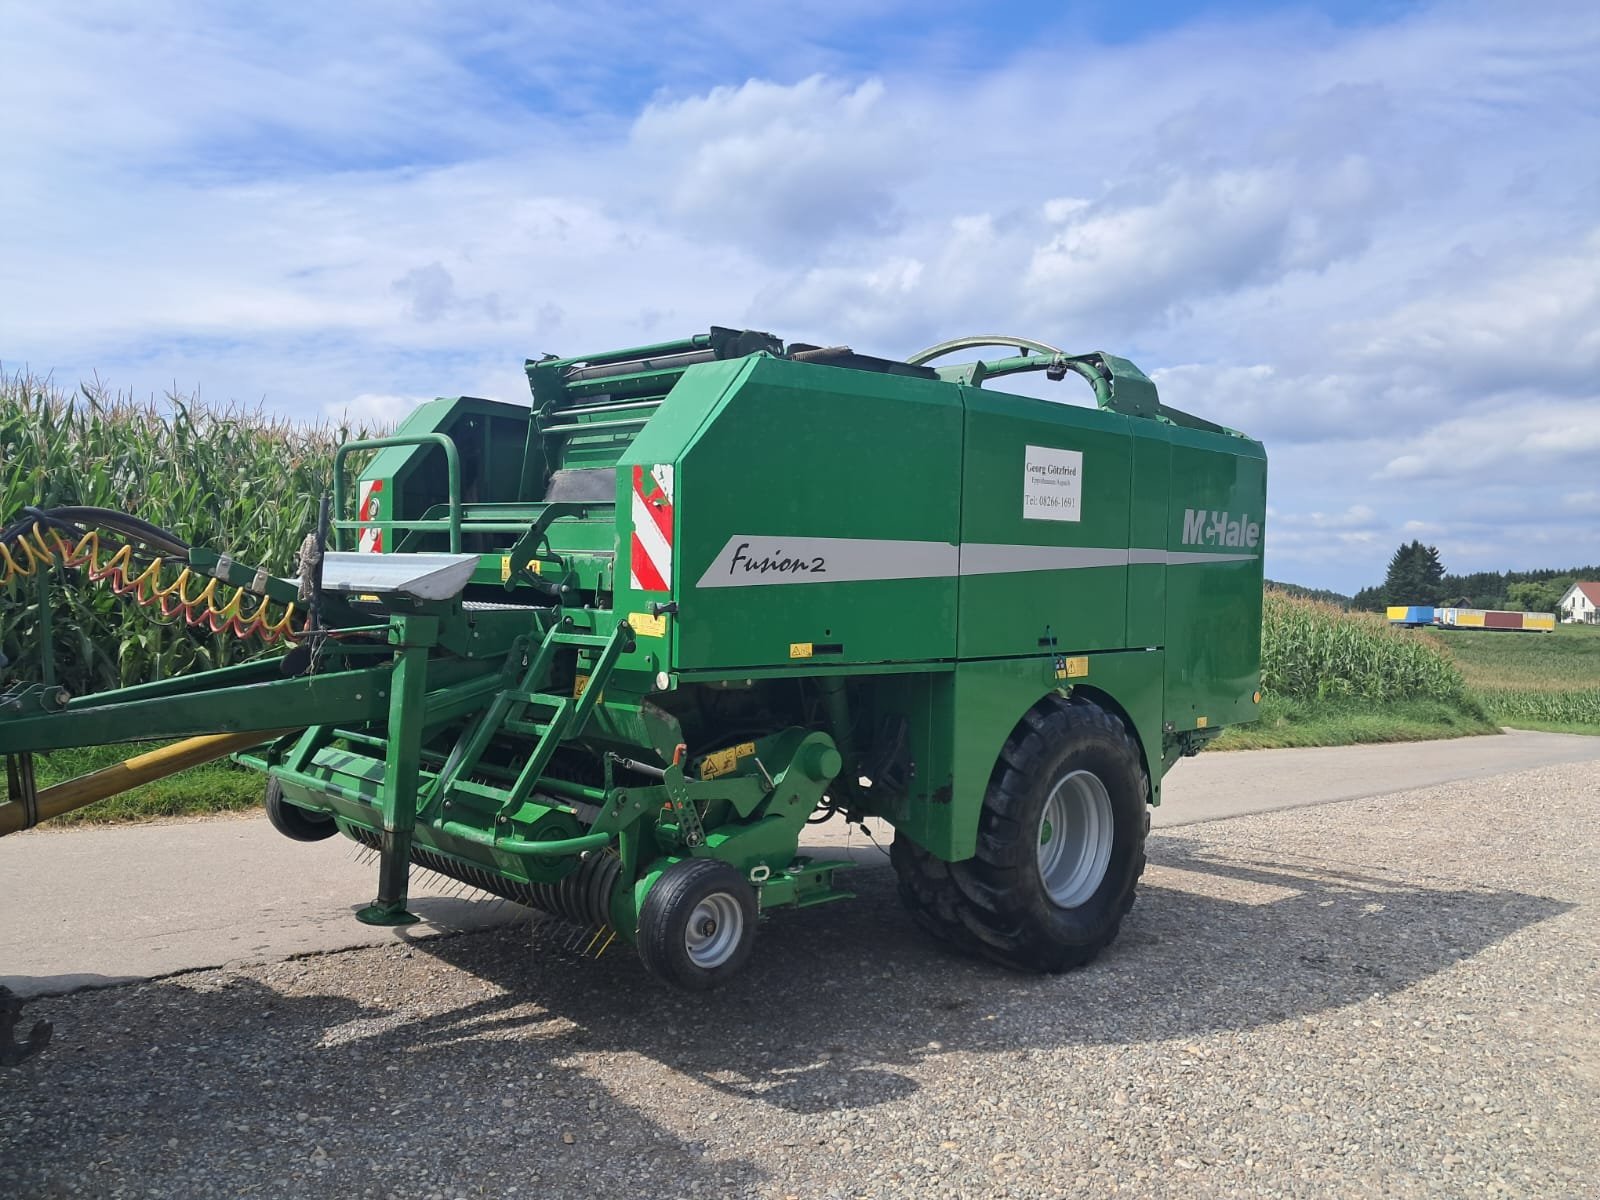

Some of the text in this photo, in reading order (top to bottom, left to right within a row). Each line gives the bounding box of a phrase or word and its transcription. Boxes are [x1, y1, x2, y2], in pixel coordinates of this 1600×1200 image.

[1026, 463, 1077, 477] Georg Götzfried
[1181, 508, 1260, 548] McHale
